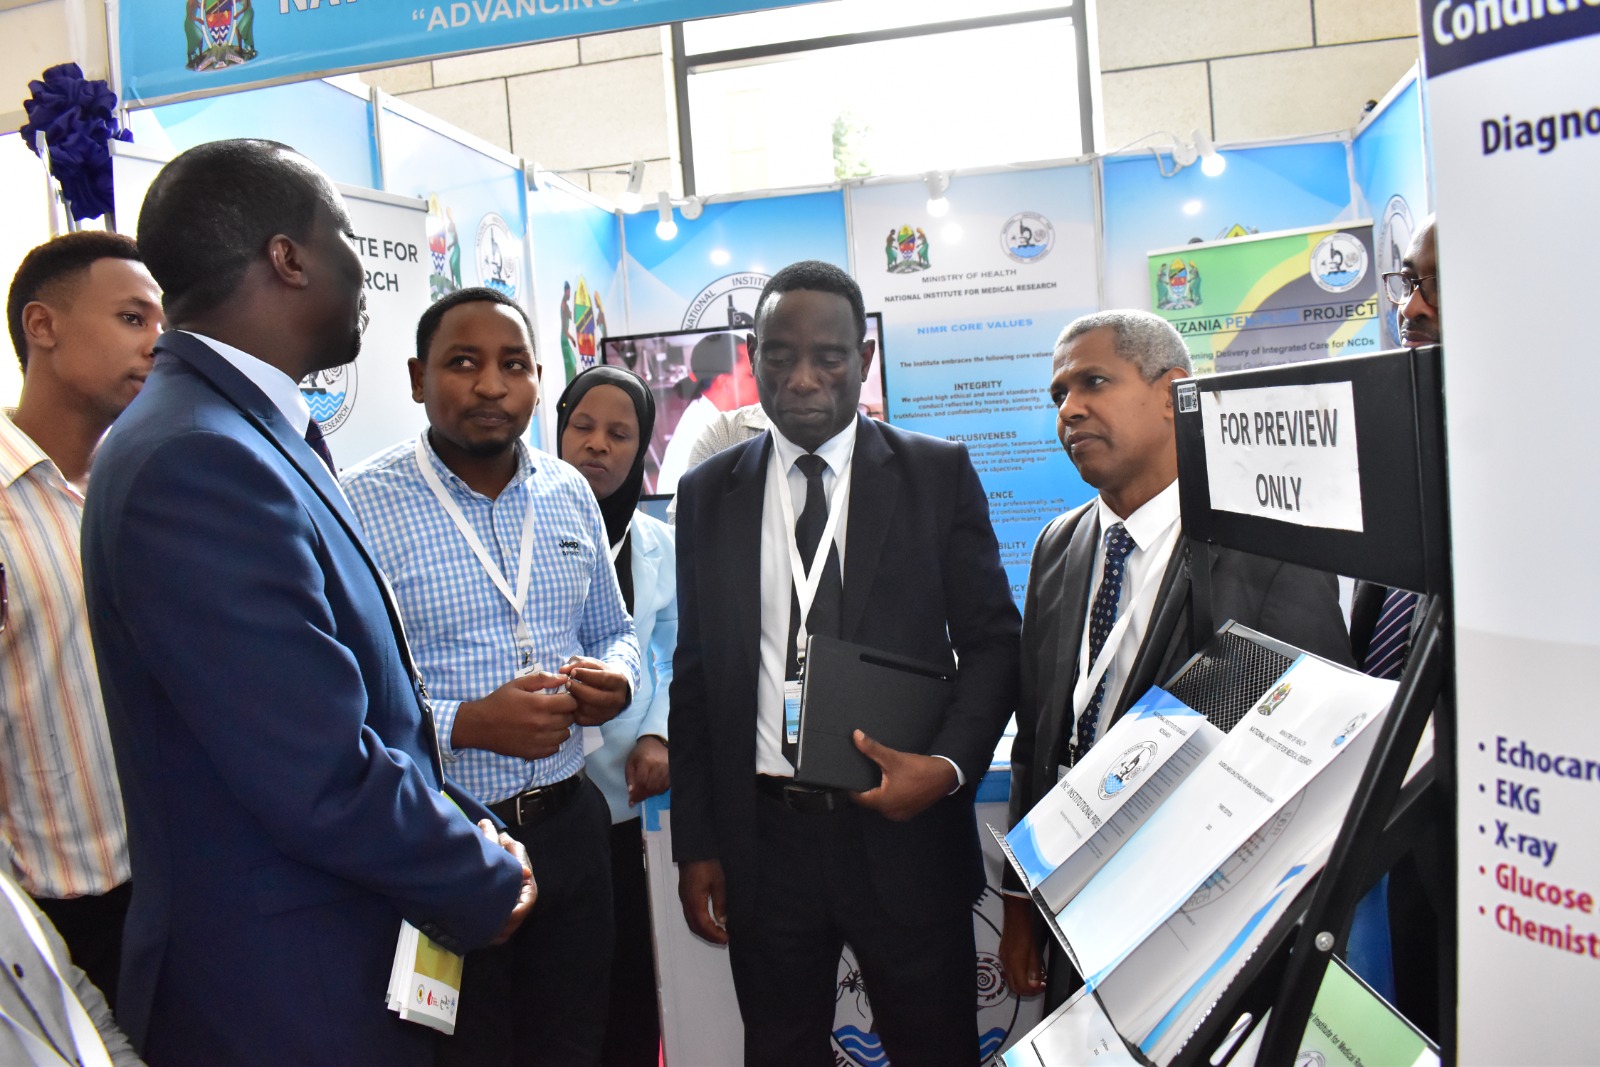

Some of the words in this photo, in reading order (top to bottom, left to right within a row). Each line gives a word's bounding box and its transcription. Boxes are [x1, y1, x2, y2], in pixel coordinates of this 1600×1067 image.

[383, 240, 419, 263] FOR
[921, 273, 963, 284] MINISTRY
[965, 271, 979, 281] OF
[980, 268, 1017, 279] HEALTH
[884, 293, 922, 303] NATIONAL
[923, 290, 962, 300] INSTITUTE
[964, 288, 980, 296] FOR
[981, 285, 1015, 295] MEDICAL
[1016, 281, 1058, 292] RESEARCH
[684, 290, 717, 330] NATIONAL
[1303, 302, 1377, 322] PROJECT
[917, 326, 948, 335] NIMR
[951, 322, 983, 332] CORE
[987, 318, 1034, 330] VALUES
[913, 359, 940, 368] Institute
[941, 357, 973, 366] embraces
[985, 353, 1015, 363] following
[1016, 352, 1031, 360] core
[1215, 348, 1251, 361] Delivery
[1251, 347, 1261, 355] of
[1261, 342, 1307, 355] Integrated
[1308, 341, 1329, 351] Care
[1331, 339, 1345, 348] for
[1347, 337, 1375, 348] NCDs
[912, 395, 934, 404] uphold
[934, 393, 949, 402] high
[950, 391, 972, 400] ethical
[1006, 387, 1038, 396] standards
[954, 380, 1002, 391] INTEGRITY
[918, 402, 944, 410] conduct
[945, 400, 974, 408] reflected
[320, 404, 350, 433] RESEARCH
[1220, 412, 1251, 446] FOR
[1254, 408, 1338, 448] PREVIEW
[946, 431, 1017, 442] INCLUSIVENESS
[1255, 473, 1302, 512] ONLY
[559, 539, 579, 549] Jeep
[1496, 735, 1600, 782] Echocar
[1496, 778, 1541, 816] EKG
[1495, 818, 1558, 868] X-ray
[1495, 863, 1594, 914] Glucose
[1312, 1014, 1334, 1039] Institute
[1330, 1033, 1341, 1046] for
[1337, 1040, 1358, 1062] Medical
